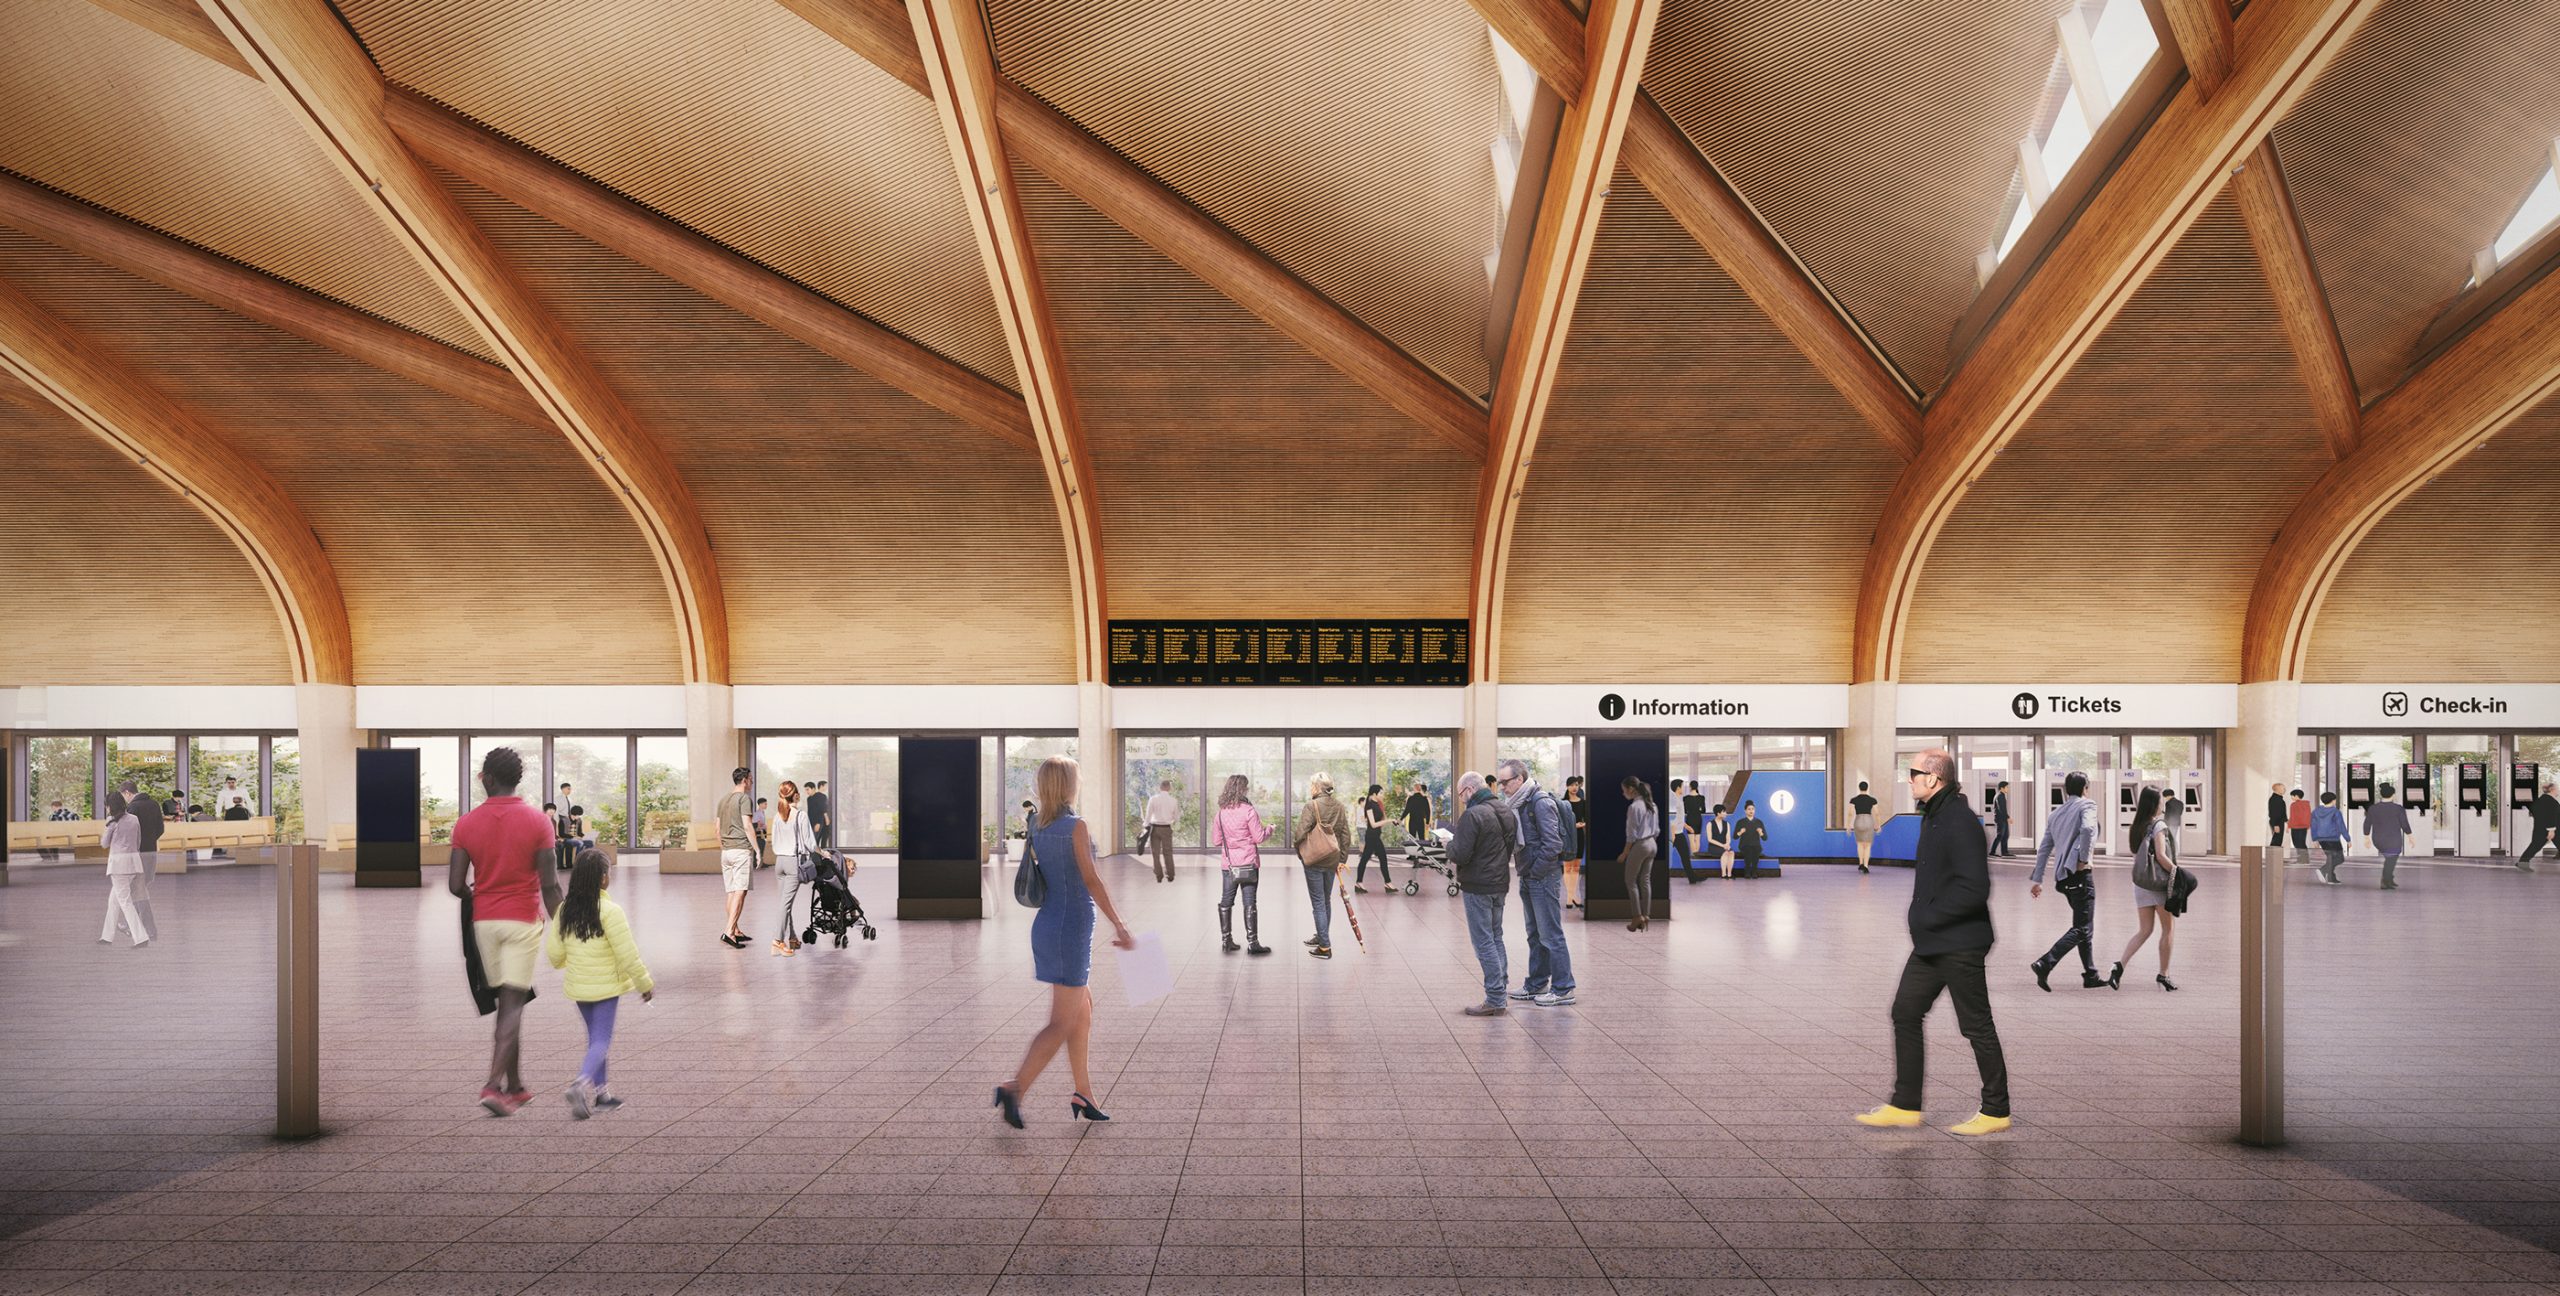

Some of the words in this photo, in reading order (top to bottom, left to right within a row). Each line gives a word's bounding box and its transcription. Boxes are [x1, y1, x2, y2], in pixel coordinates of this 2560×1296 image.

[1633, 699, 1749, 715] Information
[2048, 696, 2122, 713] Tickets
[2420, 697, 2507, 713] Check-in
